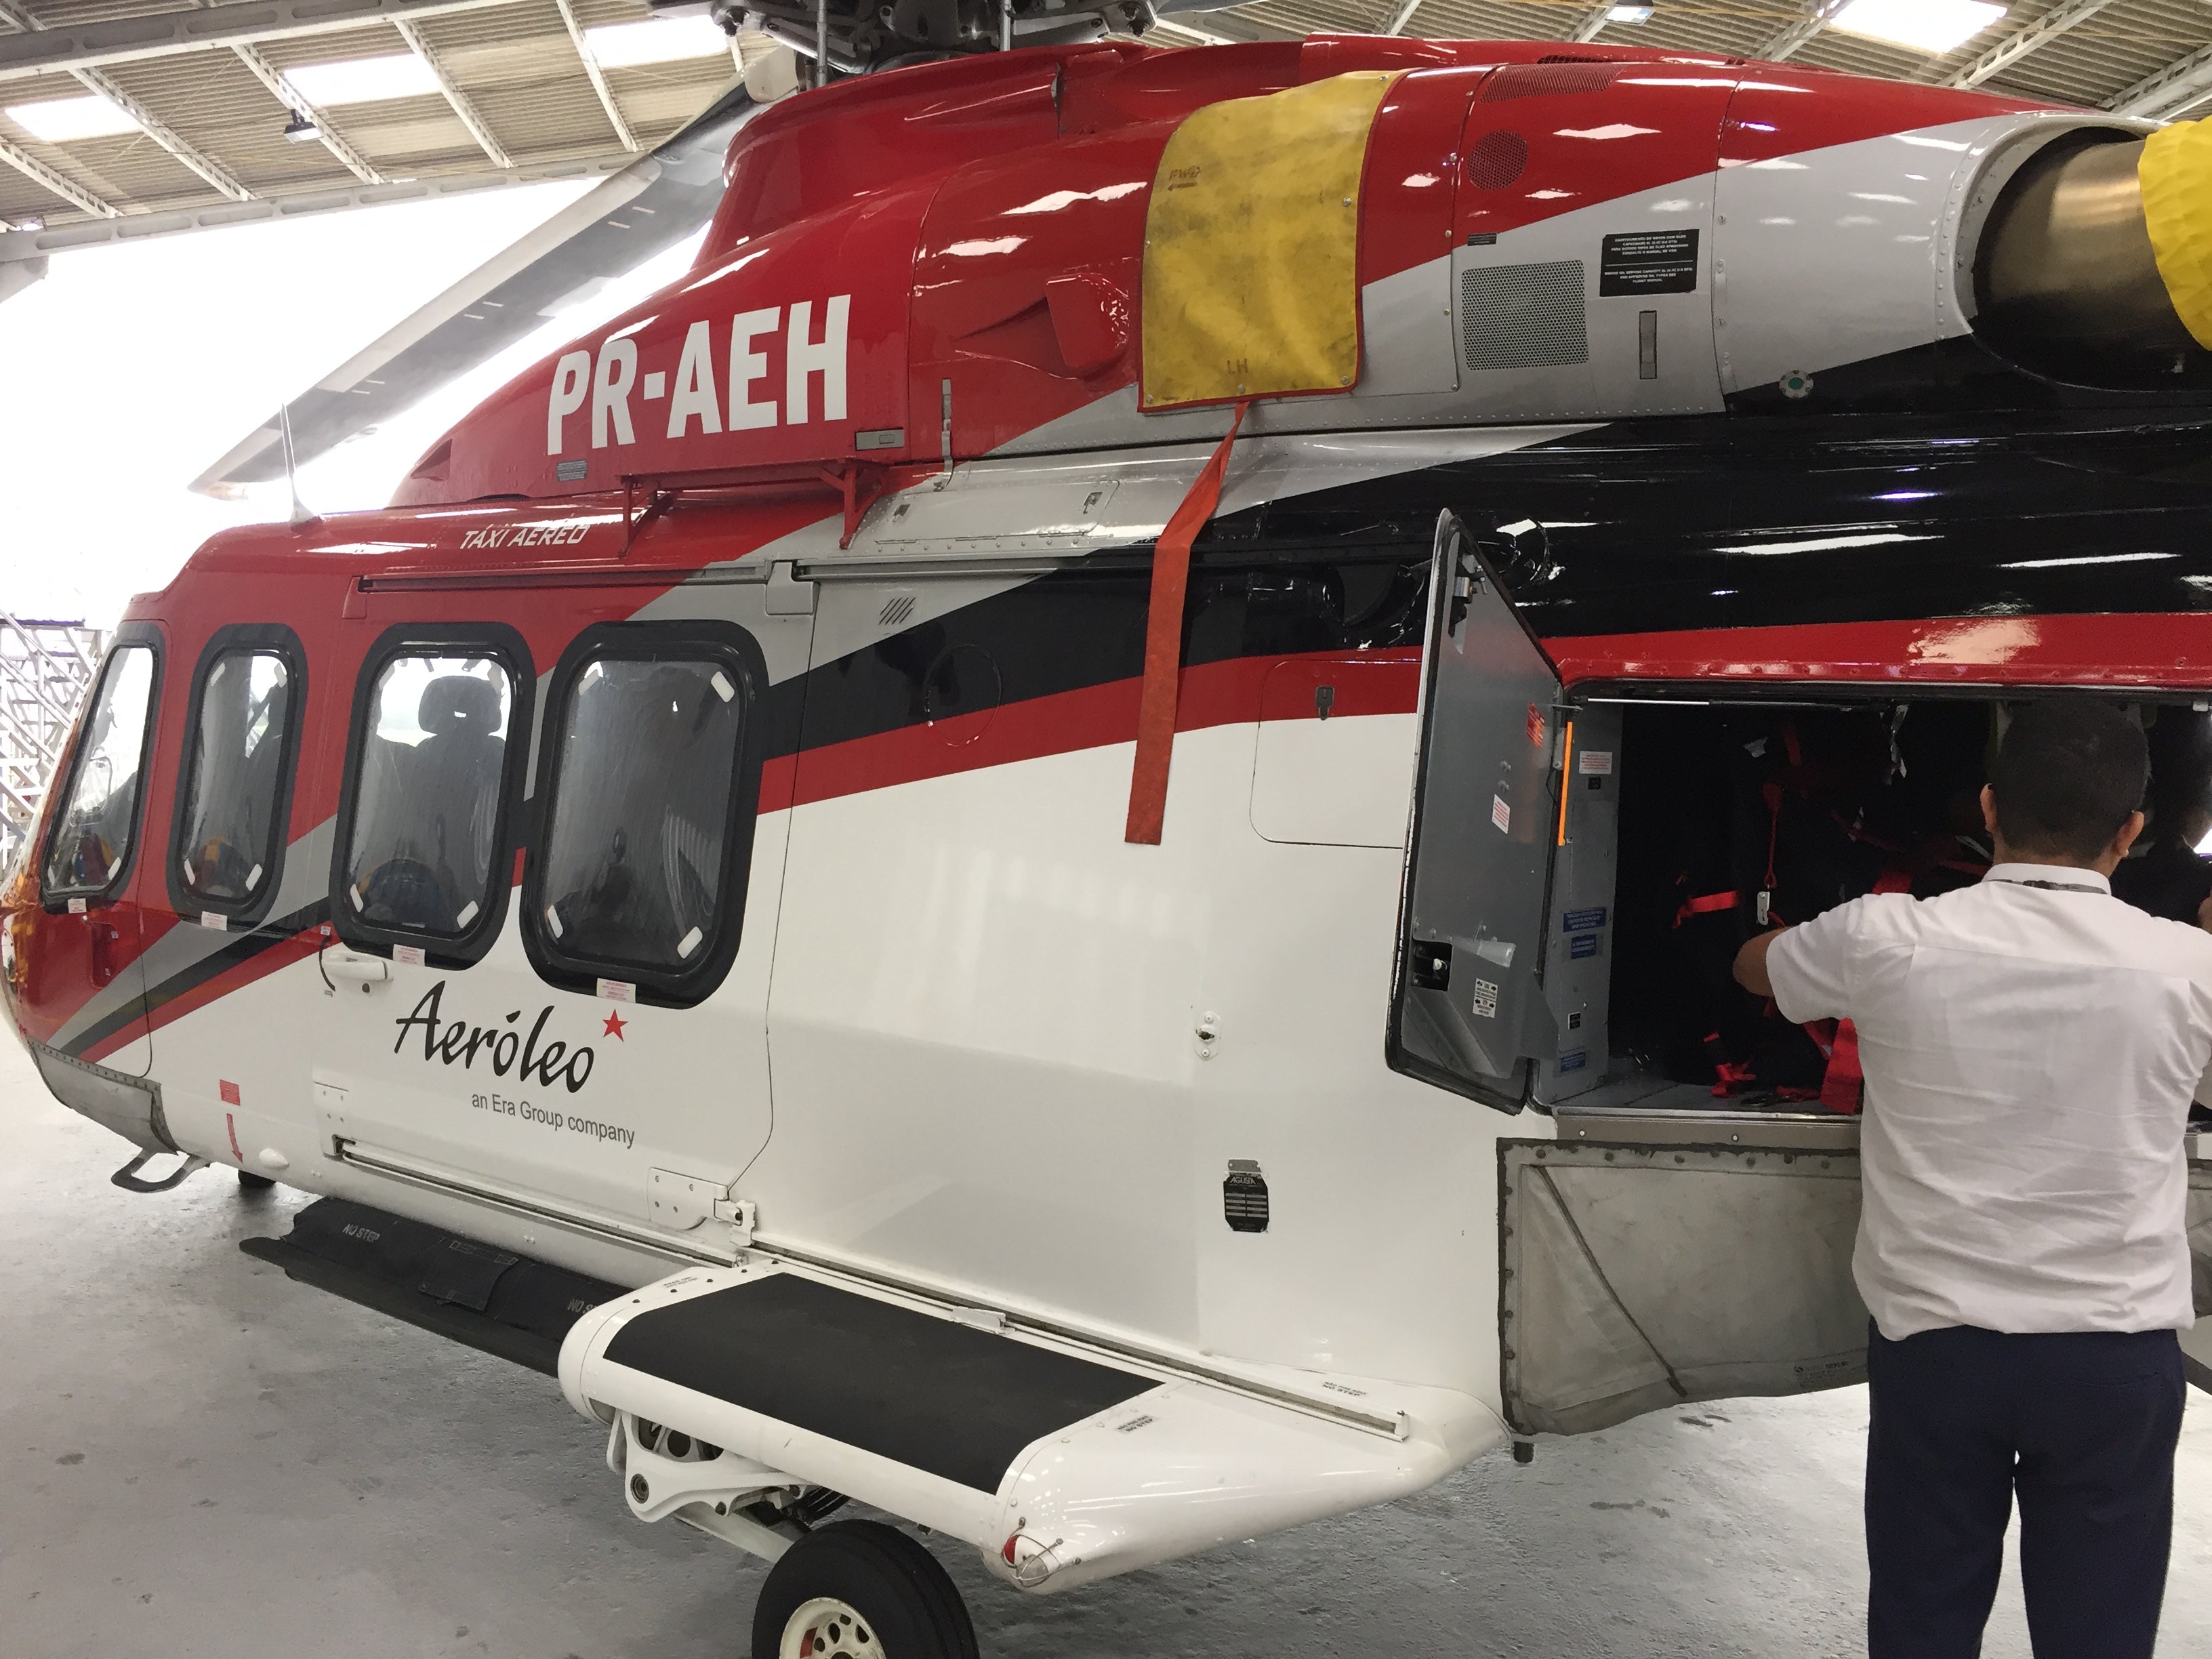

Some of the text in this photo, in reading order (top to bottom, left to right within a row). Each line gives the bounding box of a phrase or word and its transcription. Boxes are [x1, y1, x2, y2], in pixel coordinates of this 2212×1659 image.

[548, 294, 851, 455] PR-AEH
[460, 523, 508, 550] TÁXI
[394, 980, 595, 1094] Aeróleo
[472, 1093, 635, 1150] an Era Group company
[1229, 1176, 1256, 1185] AGUSTA
[342, 1223, 380, 1243] NO STEP
